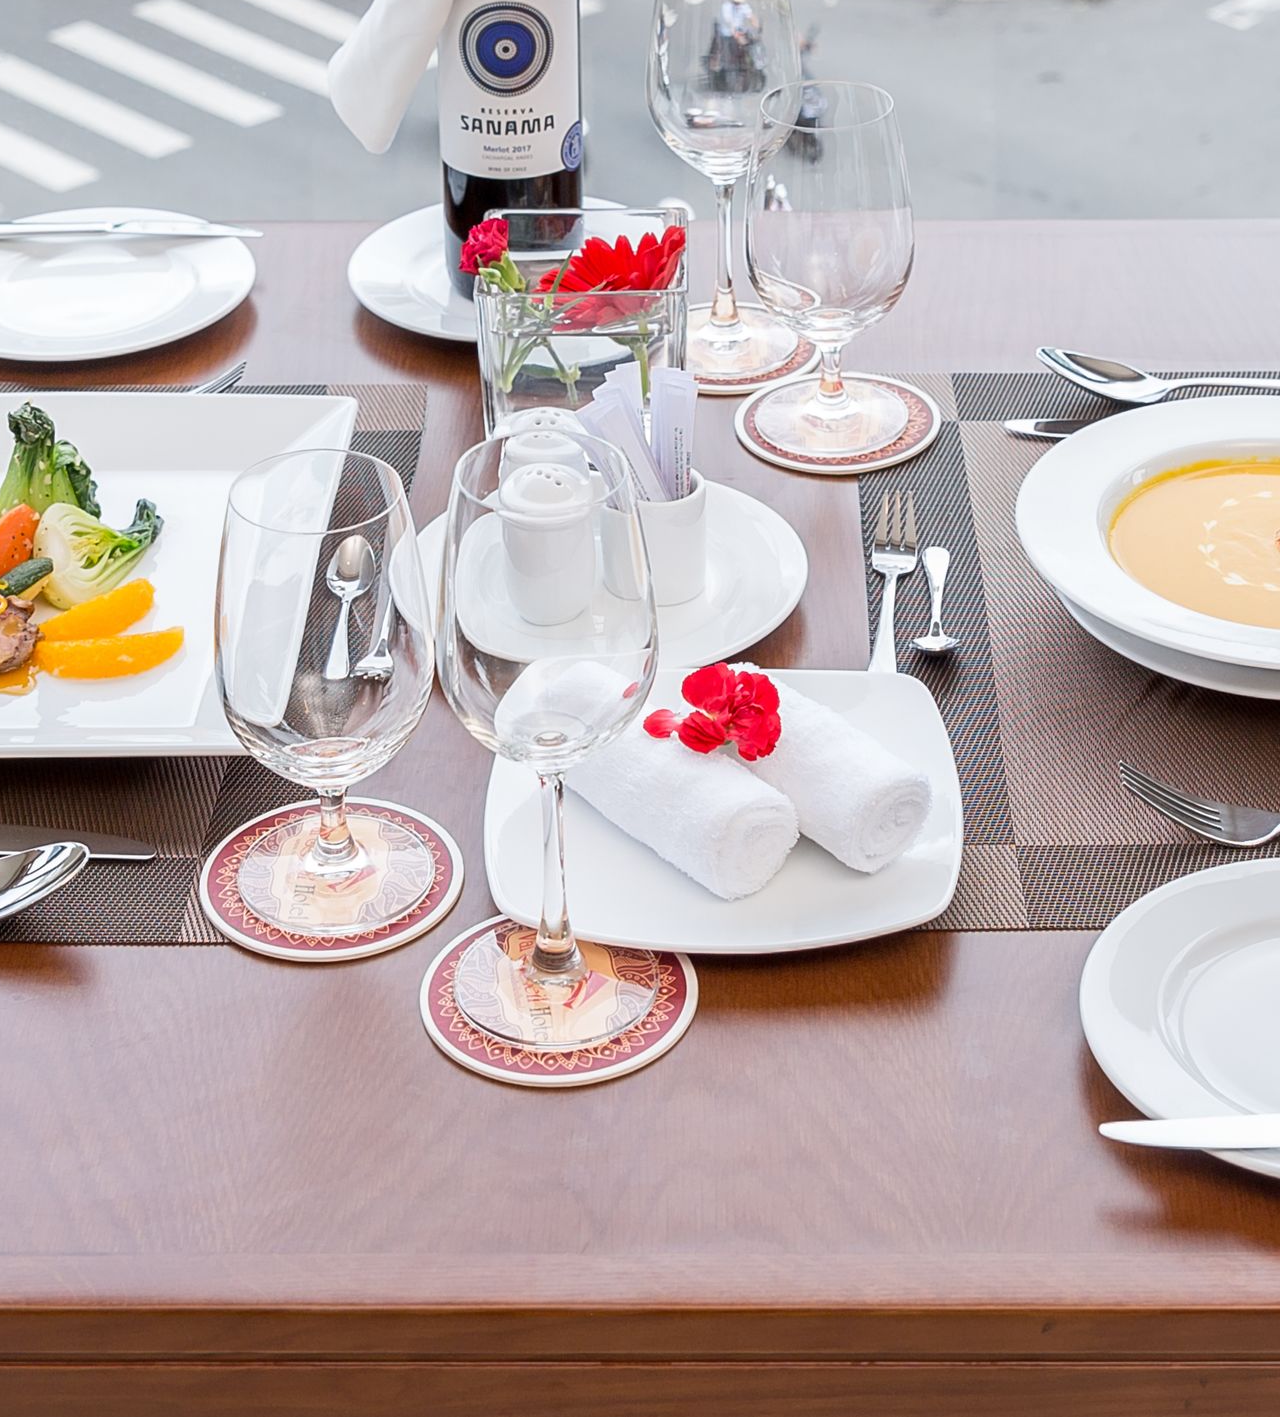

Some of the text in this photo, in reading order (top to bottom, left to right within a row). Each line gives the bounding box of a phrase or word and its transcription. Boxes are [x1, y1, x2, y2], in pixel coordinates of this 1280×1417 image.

[481, 107, 533, 115] RESERVA
[460, 115, 555, 135] SANAMA
[483, 145, 531, 153] Merlot 2017
[288, 885, 315, 919] Hotel
